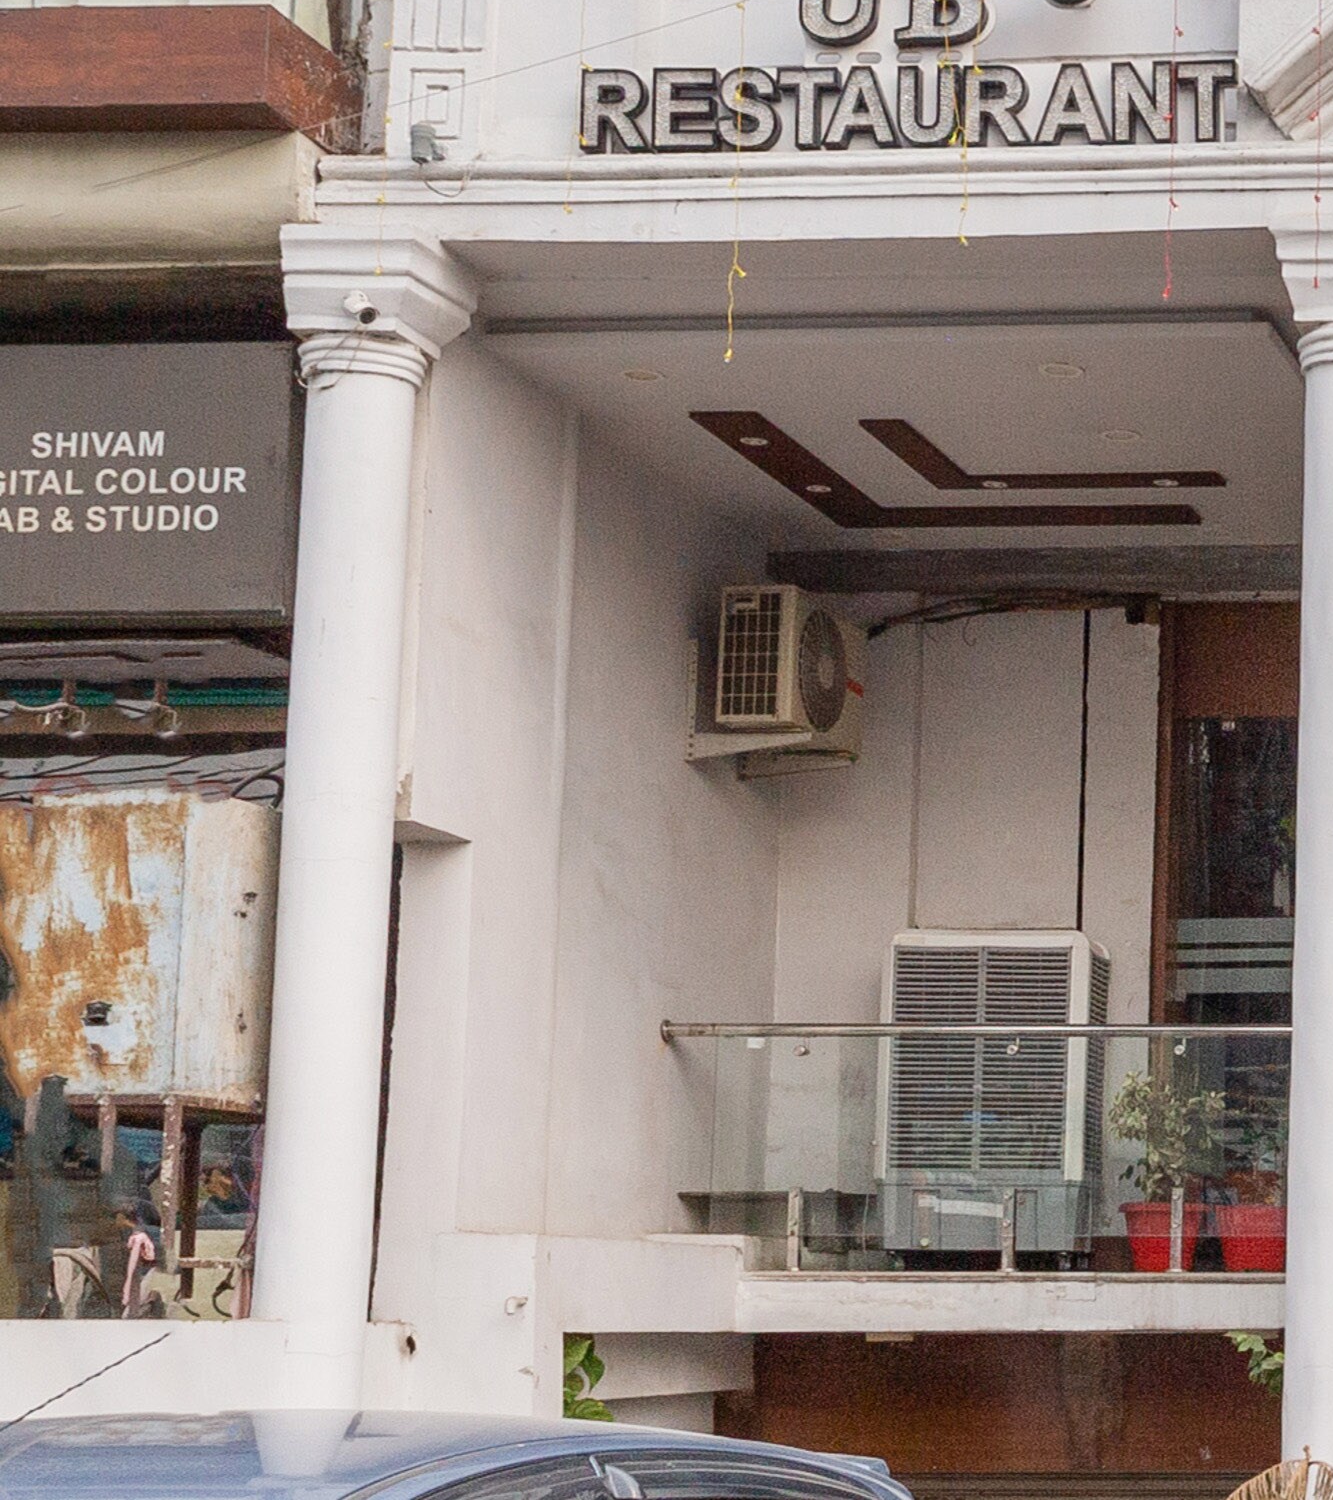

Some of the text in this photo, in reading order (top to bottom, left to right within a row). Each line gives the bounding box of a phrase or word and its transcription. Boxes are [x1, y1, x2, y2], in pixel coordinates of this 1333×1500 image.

[579, 59, 1239, 153] RESTAURANT
[31, 430, 165, 459] SHIVAM
[0, 466, 247, 497] ITAL COLOUR
[51, 505, 74, 534] &
[85, 503, 219, 533] STUDIO
